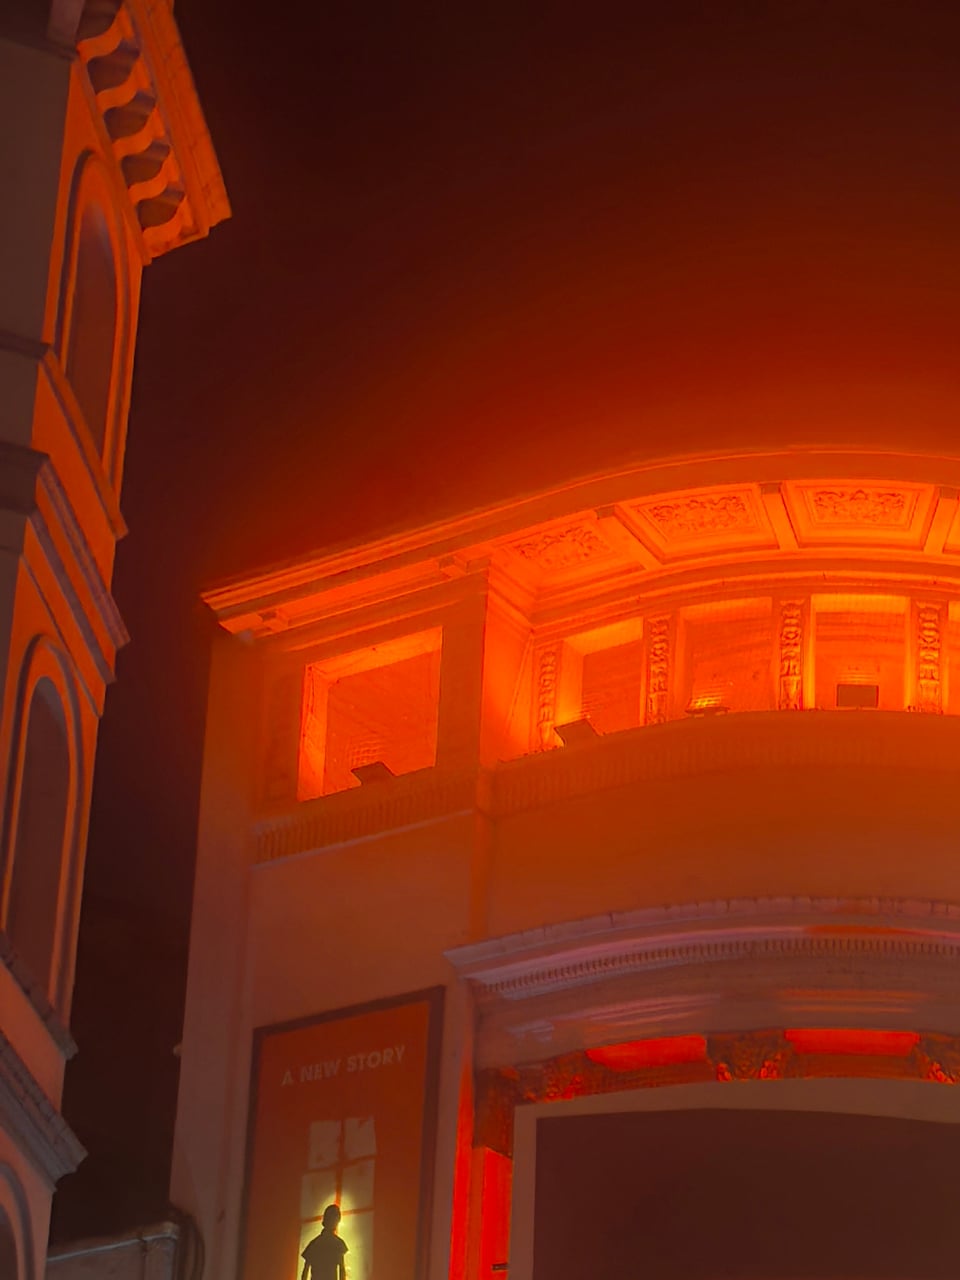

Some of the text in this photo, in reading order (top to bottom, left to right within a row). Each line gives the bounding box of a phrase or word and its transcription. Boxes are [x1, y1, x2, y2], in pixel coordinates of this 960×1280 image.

[281, 1045, 407, 1086] A NEW STORY
